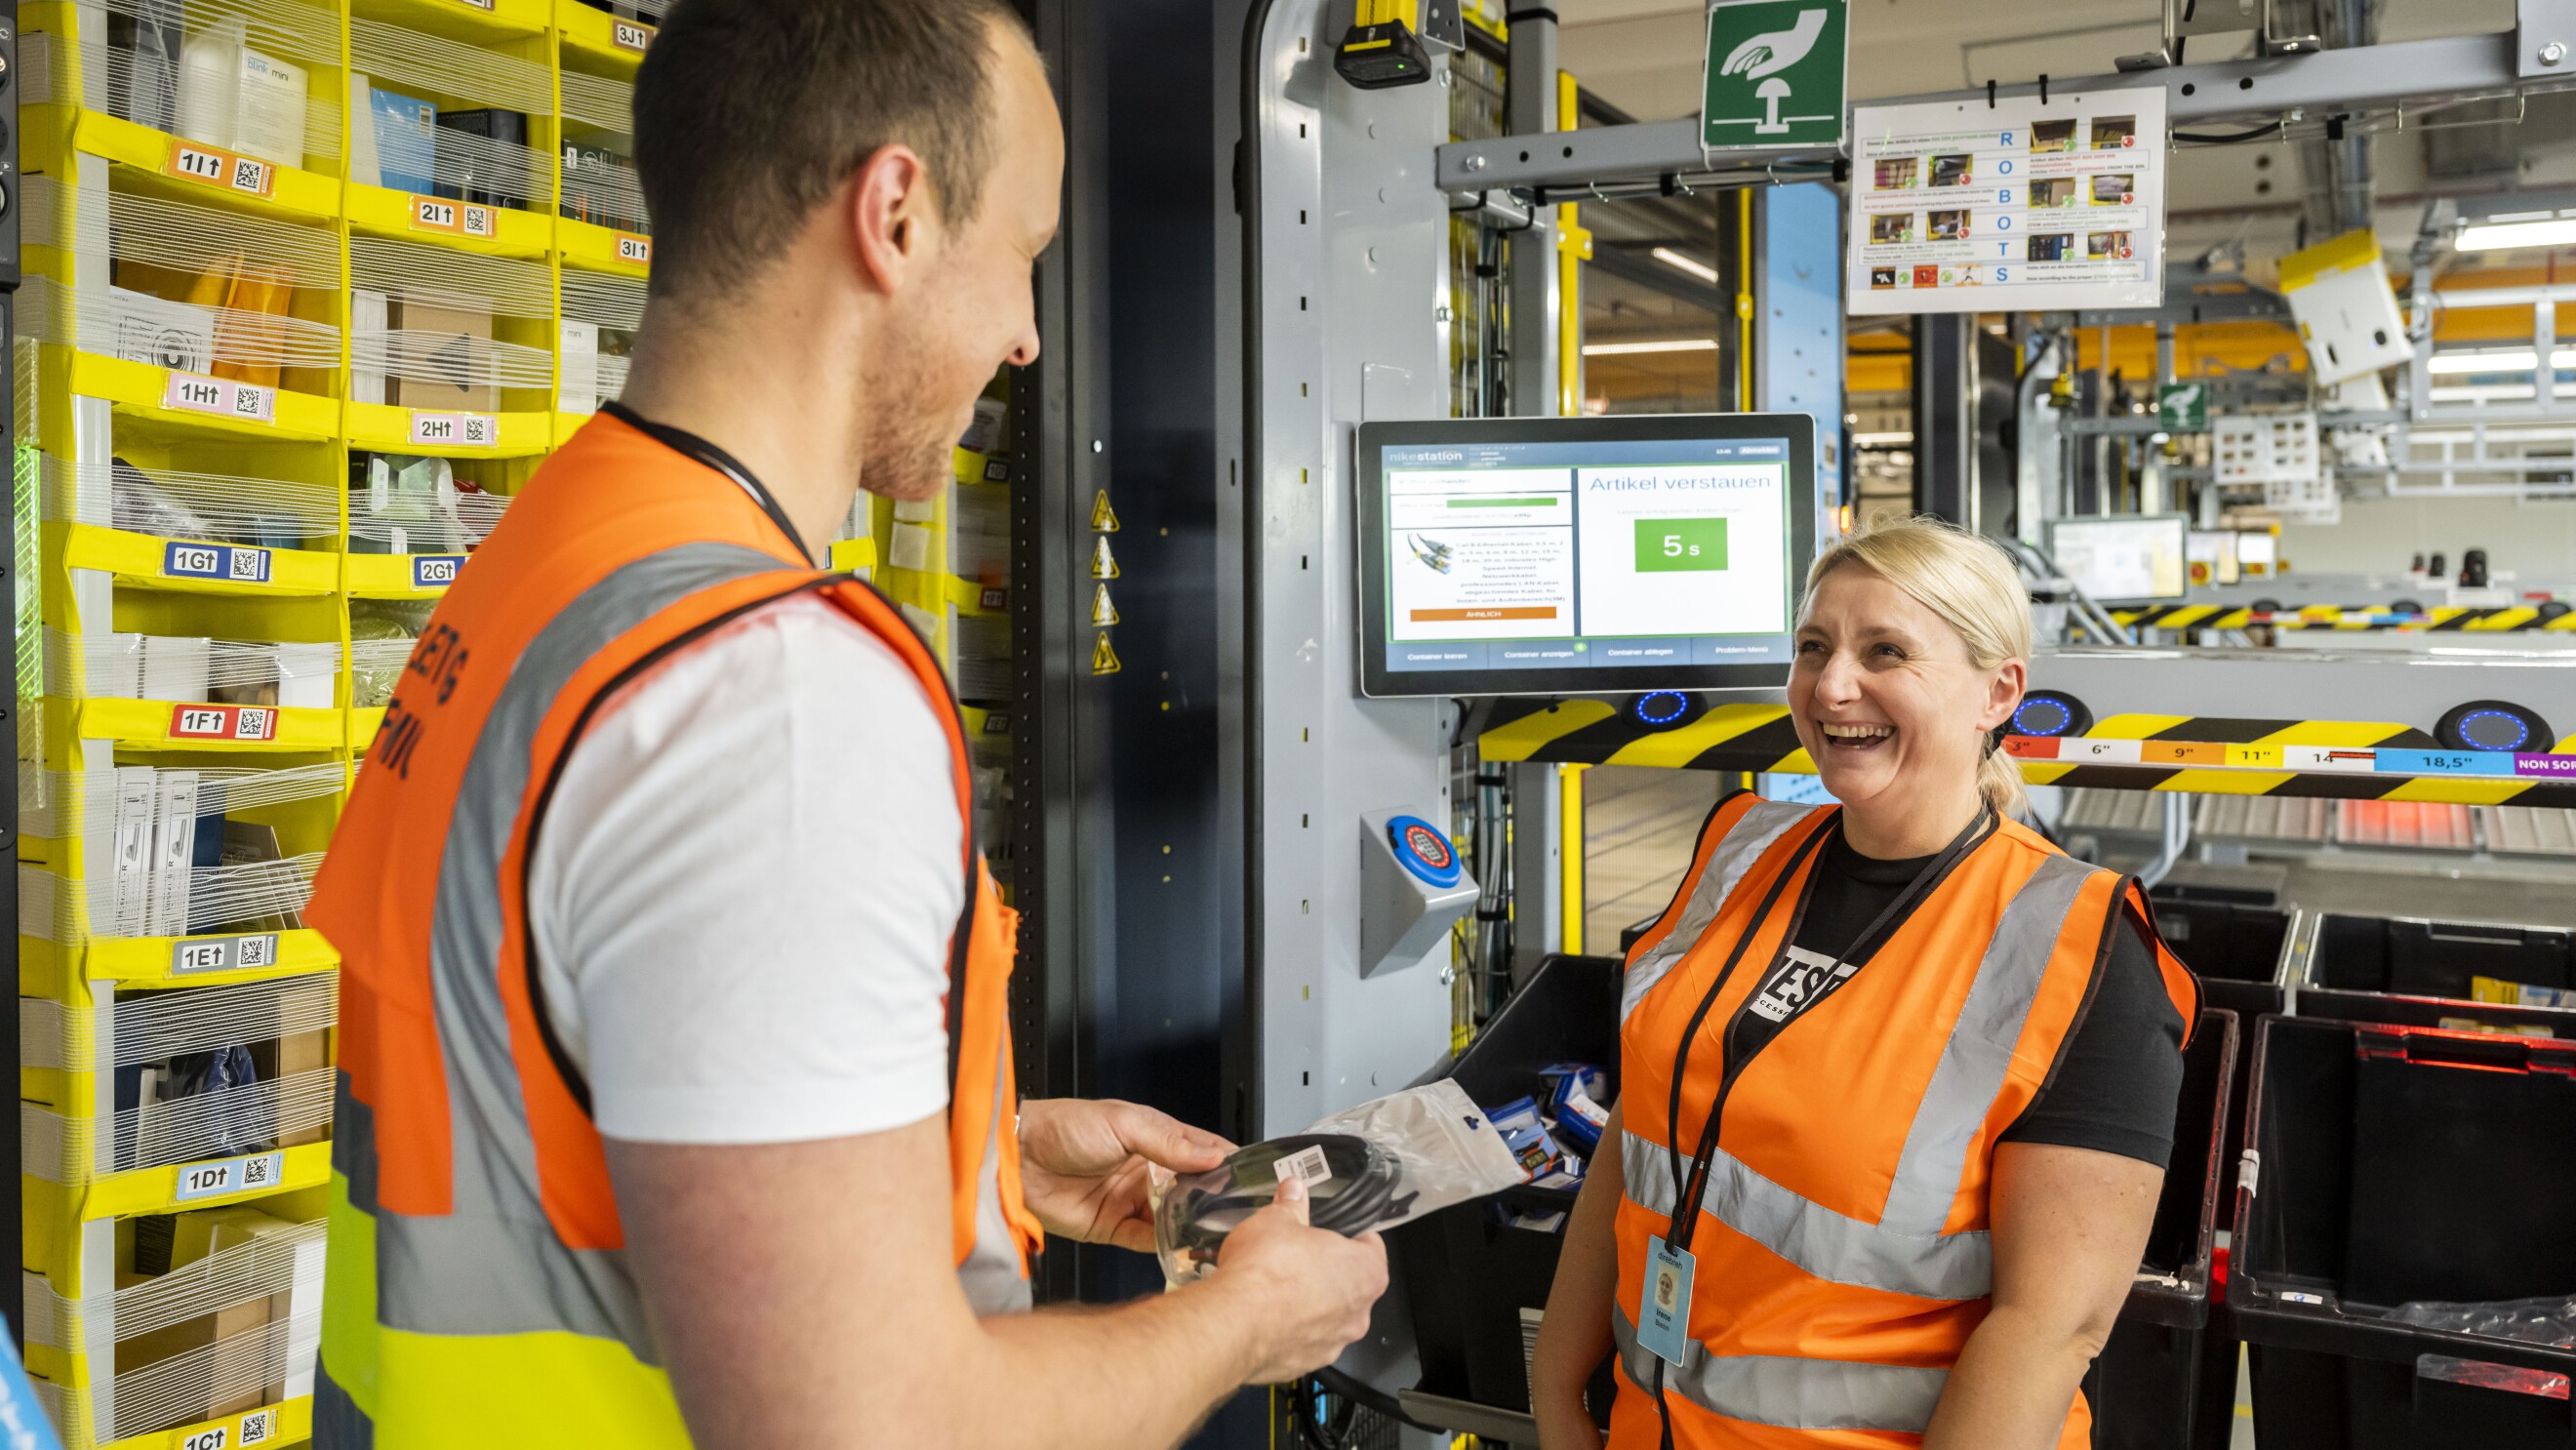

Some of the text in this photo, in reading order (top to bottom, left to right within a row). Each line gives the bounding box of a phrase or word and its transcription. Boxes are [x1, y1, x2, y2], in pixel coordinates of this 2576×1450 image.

[620, 27, 634, 43] 3J
[247, 57, 289, 82] blink mini
[181, 383, 209, 403] 1H
[422, 421, 443, 437] 2H
[1590, 475, 1770, 491] Artikel verstauen
[1663, 535, 1700, 557] 5 s
[178, 550, 205, 570] 1G
[423, 563, 446, 580] 2G
[1407, 652, 1468, 662] Container leeren
[1505, 650, 1574, 660] Container anzeigen
[185, 712, 210, 730] 1F
[2092, 745, 2111, 755] 6"
[2175, 747, 2194, 758] 9"
[2241, 750, 2271, 761] 11"
[2423, 756, 2473, 769] 18,5"
[2518, 759, 2550, 770] NON
[185, 947, 211, 967] 1E
[190, 1170, 217, 1190] 1D
[1656, 1308, 1671, 1322] Irene
[186, 1433, 214, 1450] 1C
